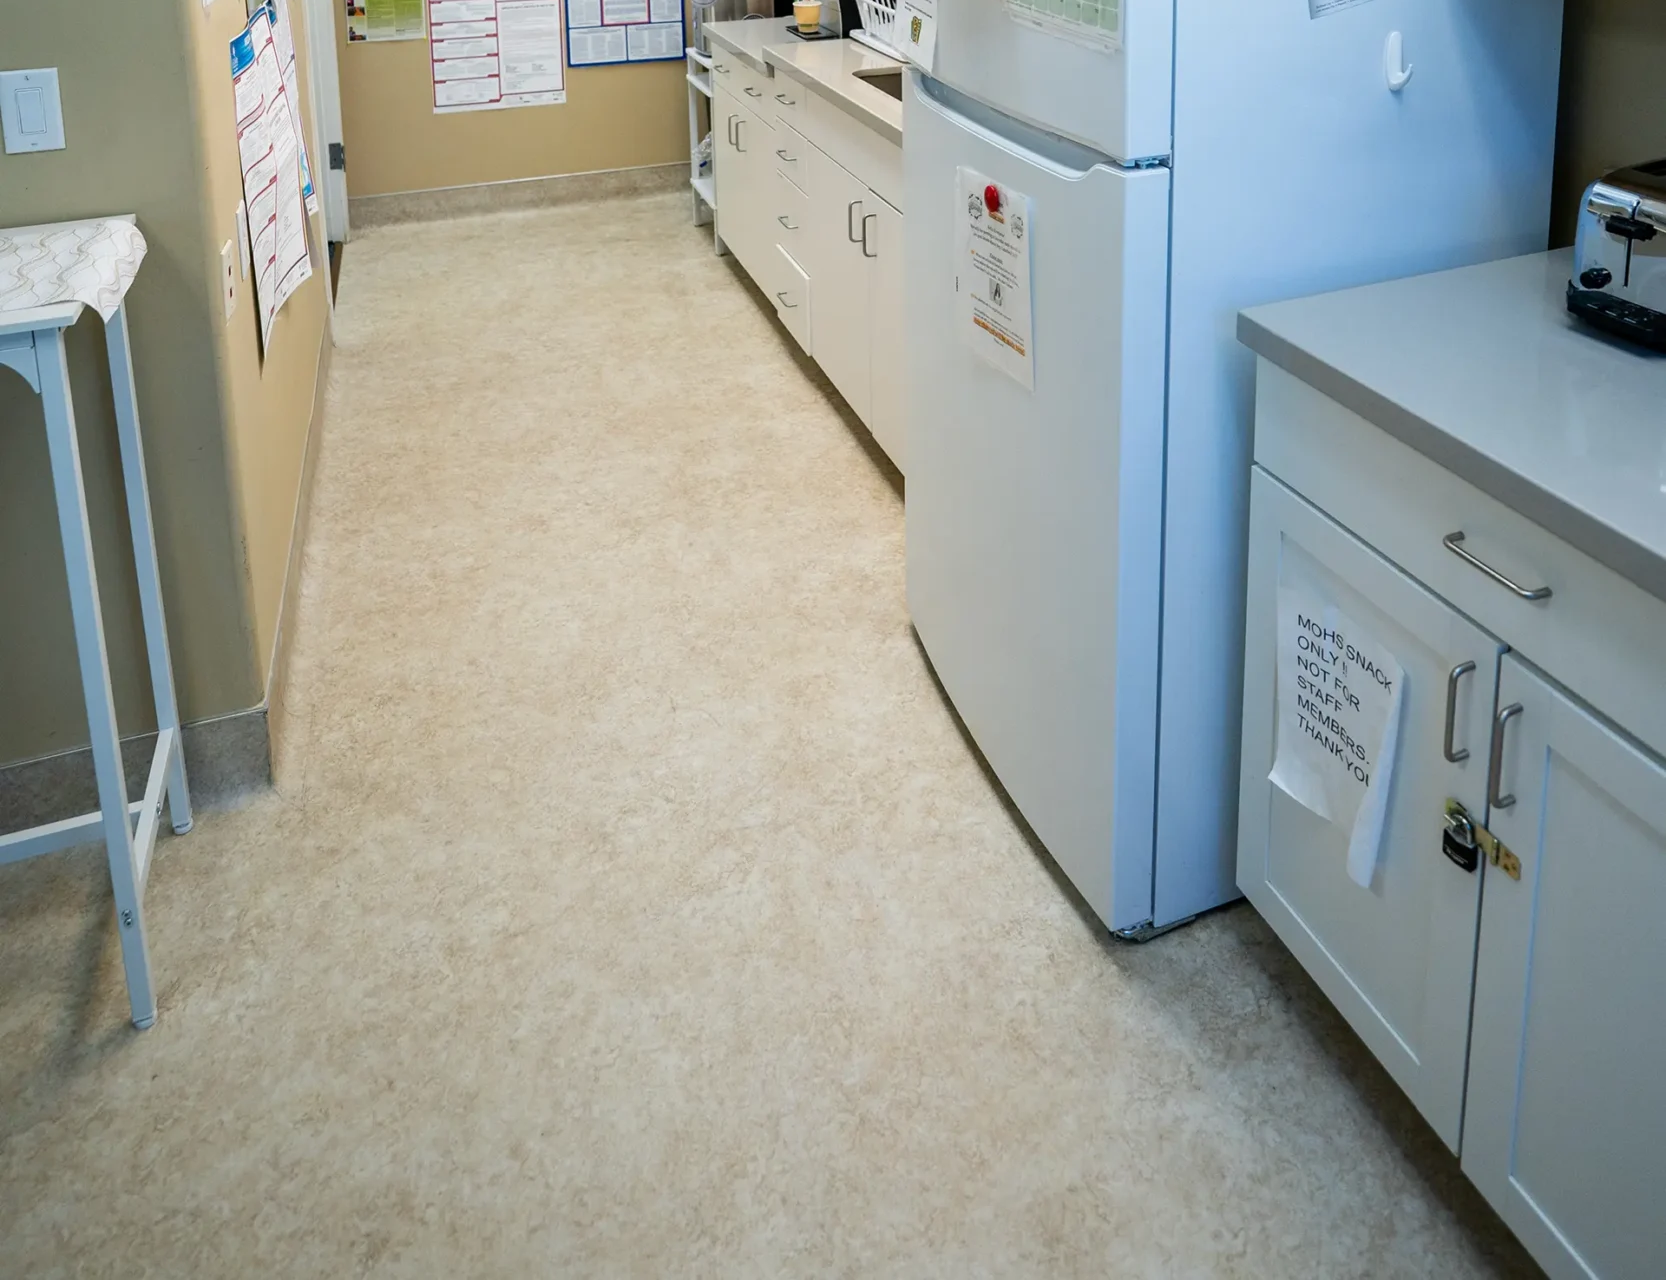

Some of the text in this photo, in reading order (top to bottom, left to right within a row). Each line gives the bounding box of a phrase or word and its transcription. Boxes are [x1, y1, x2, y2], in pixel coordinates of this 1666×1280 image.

[1297, 635, 1340, 671] ONLY
[1298, 614, 1393, 696] MOHS SNACK
[1297, 655, 1361, 713] NOT FOR
[1297, 675, 1343, 713] STAFF
[1297, 694, 1370, 765] MEMBERS.
[1297, 713, 1344, 763] THANK
